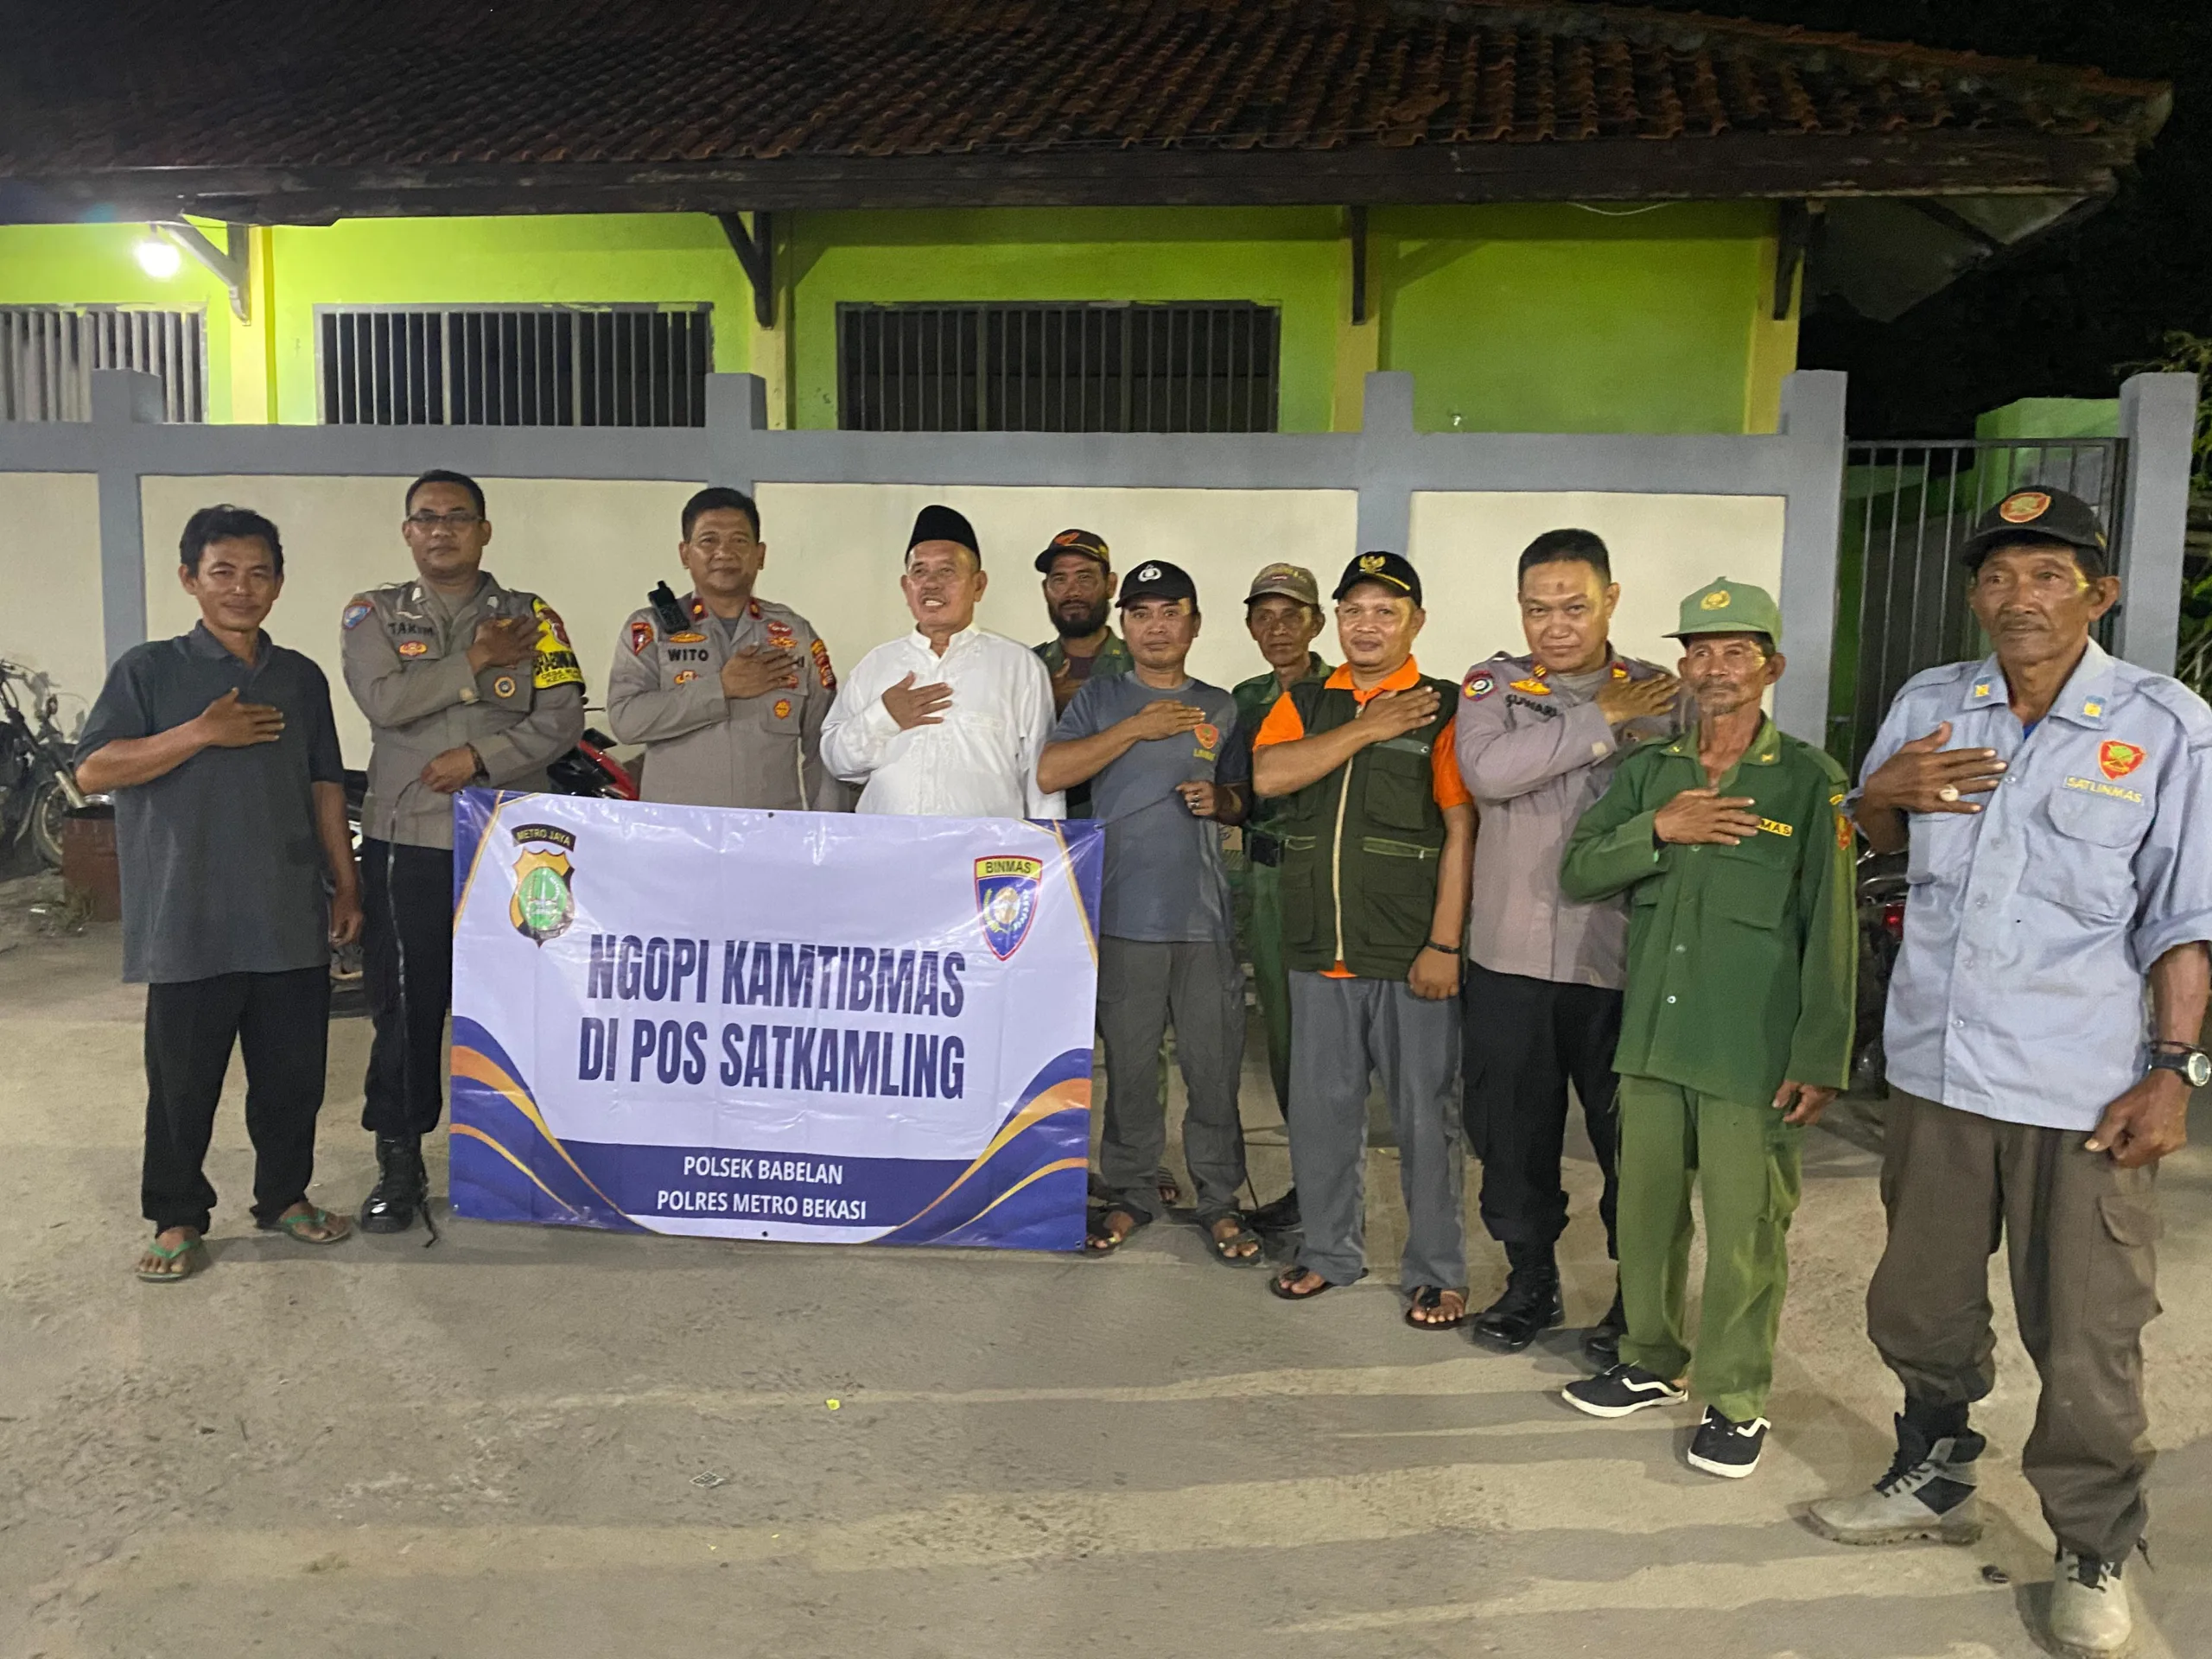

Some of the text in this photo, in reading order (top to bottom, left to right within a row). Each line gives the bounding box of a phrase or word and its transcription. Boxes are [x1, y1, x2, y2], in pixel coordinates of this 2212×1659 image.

[668, 649, 709, 662] WITO
[2066, 777, 2143, 803] SATLINMAS
[516, 829, 571, 847] METRO JAYA
[985, 860, 1032, 874] BINMAS
[587, 934, 966, 1018] NGOPI KAMTIBMAS
[578, 1017, 965, 1099] DI POS SATKAMLING
[683, 1156, 843, 1185] POLSEK BABELAN
[657, 1190, 867, 1220] POLRES METRO BEKASI
